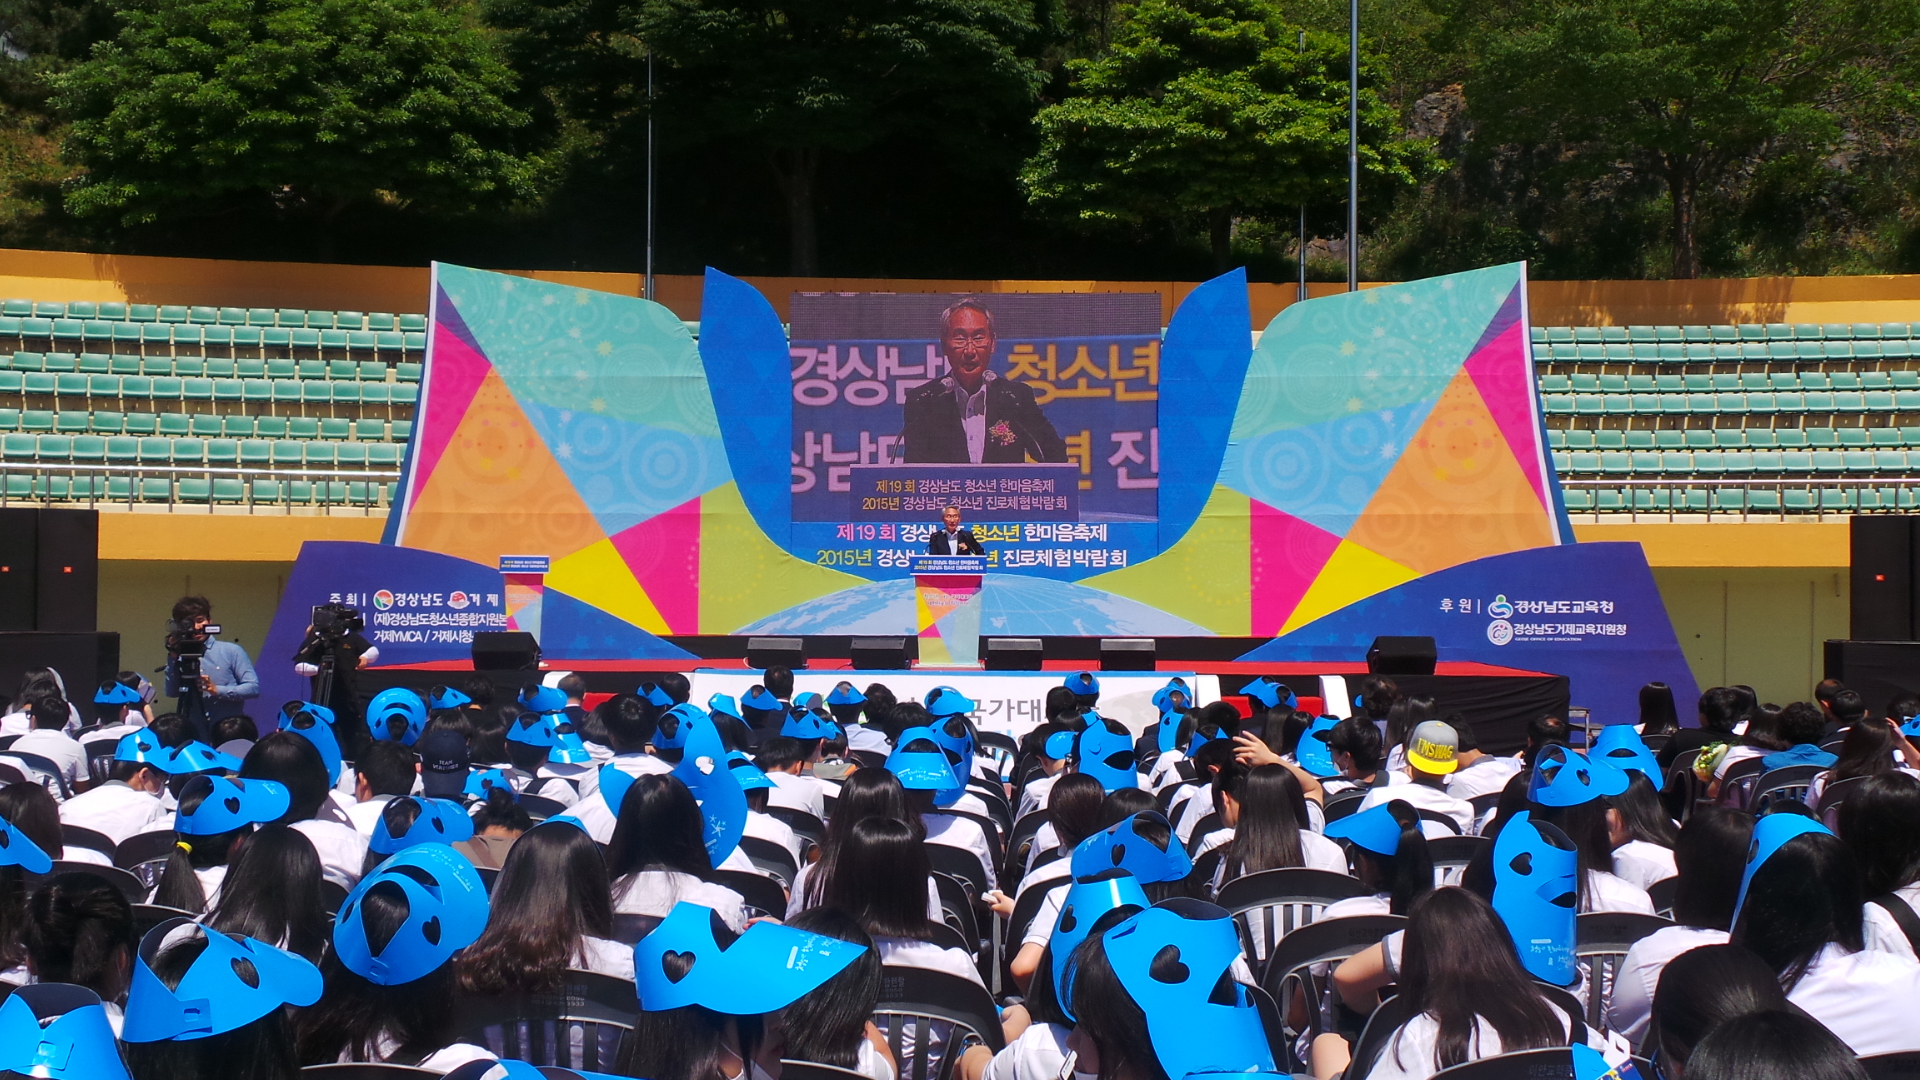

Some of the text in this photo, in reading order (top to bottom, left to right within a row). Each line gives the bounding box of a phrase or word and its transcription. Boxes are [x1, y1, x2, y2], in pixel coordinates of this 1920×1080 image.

[790, 341, 1159, 406] 경상남 청소년
[919, 480, 962, 493] 경상남도
[964, 479, 997, 493] 청소년
[1000, 479, 1054, 493] 한마음축제
[863, 497, 900, 510] 2015년
[903, 496, 946, 510] 경상남도
[971, 524, 1020, 542] 청소년
[1024, 524, 1108, 542] 한마음축제
[817, 549, 872, 567] 2015년
[395, 593, 443, 606] 경상남도
[1514, 600, 1614, 614] 경상남도교육청
[1514, 623, 1627, 635] 경상남도거제교육지원청
